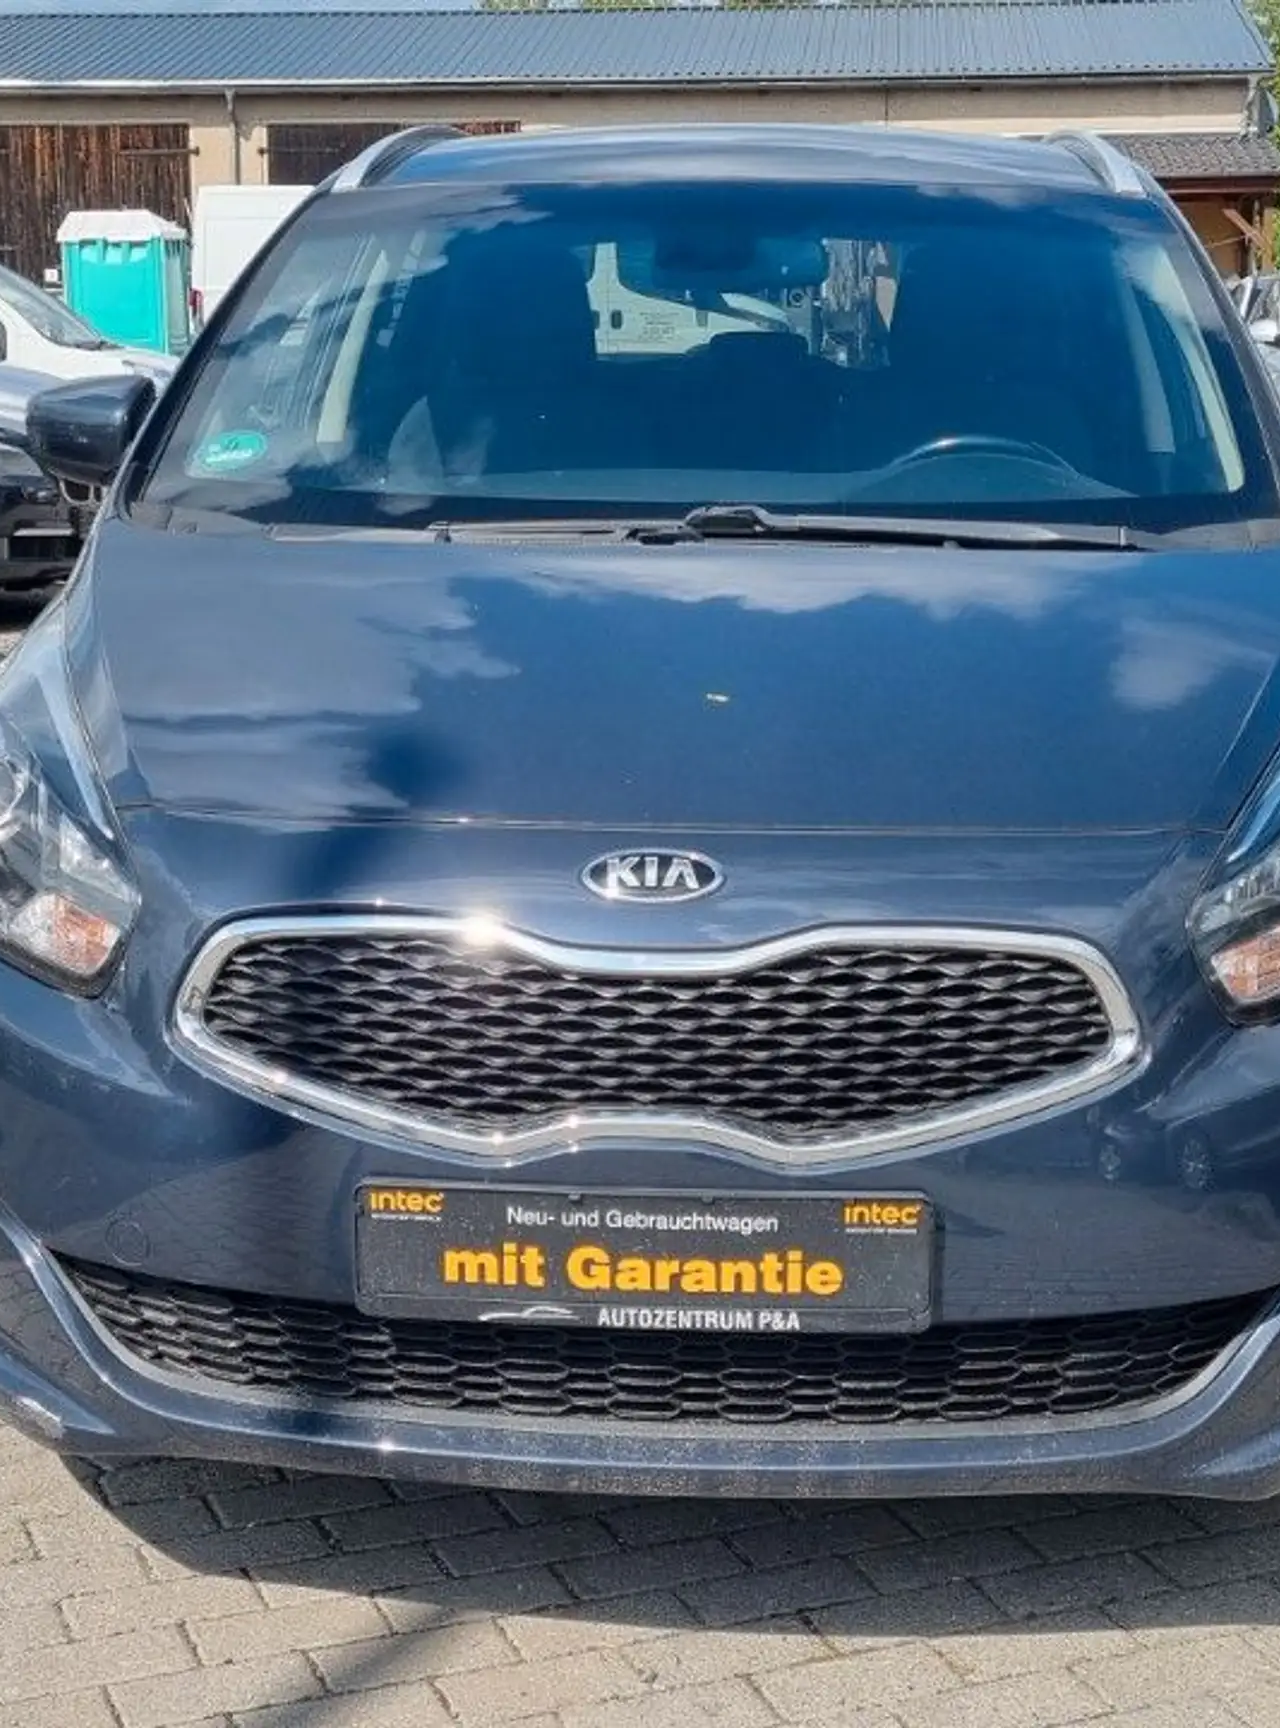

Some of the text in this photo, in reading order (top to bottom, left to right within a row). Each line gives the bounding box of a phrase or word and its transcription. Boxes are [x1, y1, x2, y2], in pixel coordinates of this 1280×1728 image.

[606, 856, 700, 889] KIA
[370, 1191, 444, 1213] intec
[844, 1202, 919, 1225] intec
[507, 1206, 779, 1235] Neu- und Gebrauchtwagen
[444, 1241, 843, 1296] mit Garantie
[598, 1307, 801, 1331] AUTOZENTRUM P&A
